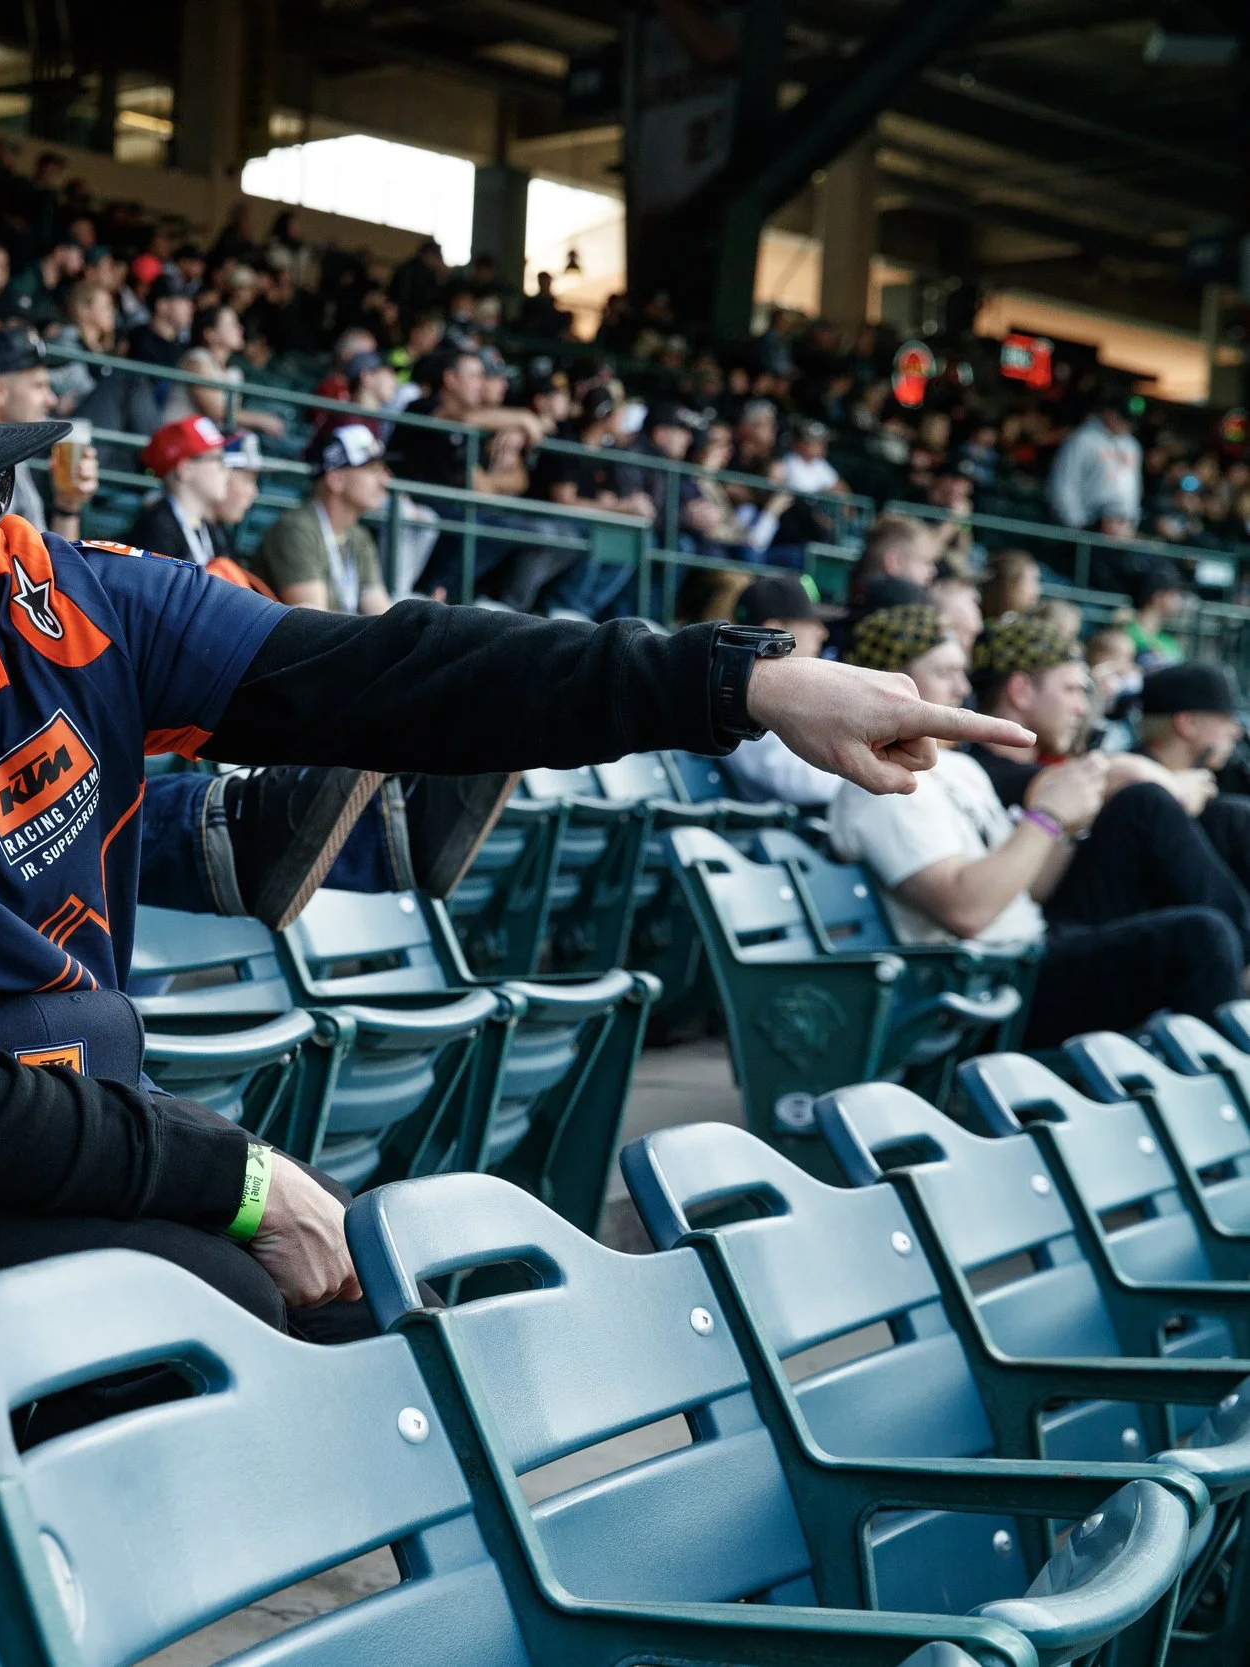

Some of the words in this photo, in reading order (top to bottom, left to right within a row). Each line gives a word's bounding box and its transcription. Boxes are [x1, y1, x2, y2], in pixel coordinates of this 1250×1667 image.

[0, 744, 74, 817] KTM
[4, 807, 66, 856] RACING
[66, 767, 99, 810] TEAM
[20, 861, 44, 882] JR.
[251, 1175, 264, 1197] Zone
